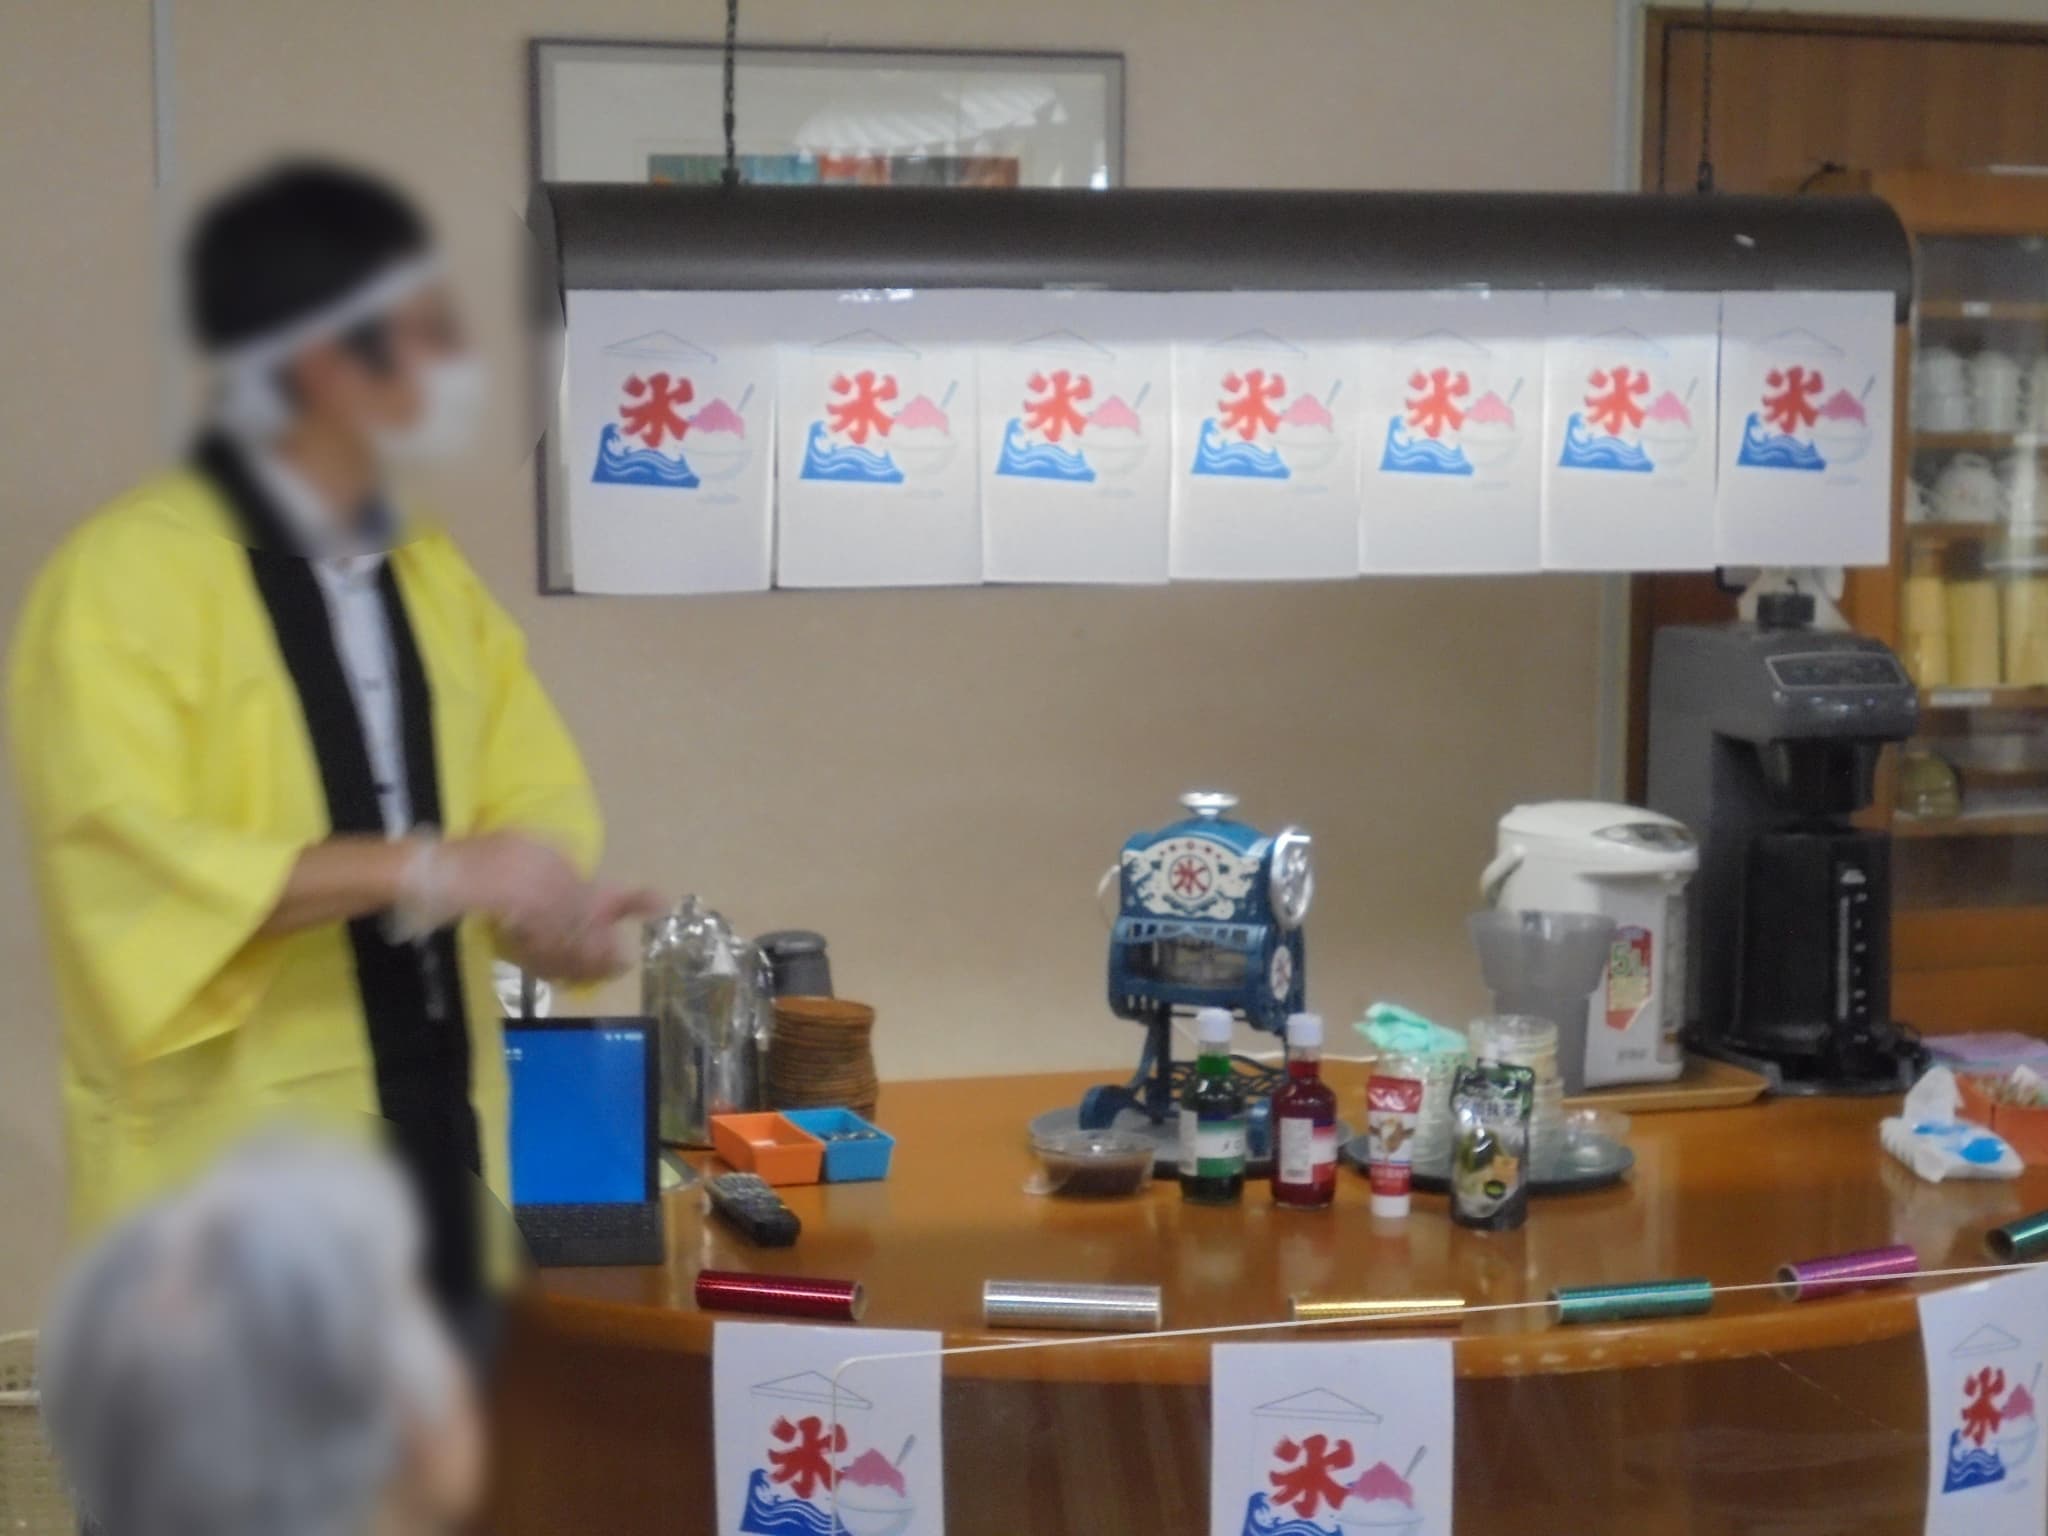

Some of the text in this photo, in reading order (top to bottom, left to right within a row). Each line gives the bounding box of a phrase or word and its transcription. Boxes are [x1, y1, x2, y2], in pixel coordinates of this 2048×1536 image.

[618, 371, 693, 448] 氷
[826, 369, 898, 444] 氷
[1023, 368, 1095, 441] 氷
[1217, 367, 1286, 440] 氷
[1405, 366, 1472, 437] 氷
[1583, 365, 1650, 435] 氷
[1761, 366, 1823, 434] 氷
[1171, 858, 1210, 895] 氷
[1961, 1366, 2004, 1447] 氷
[767, 1415, 847, 1499] 氷
[1268, 1433, 1353, 1516] 氷
